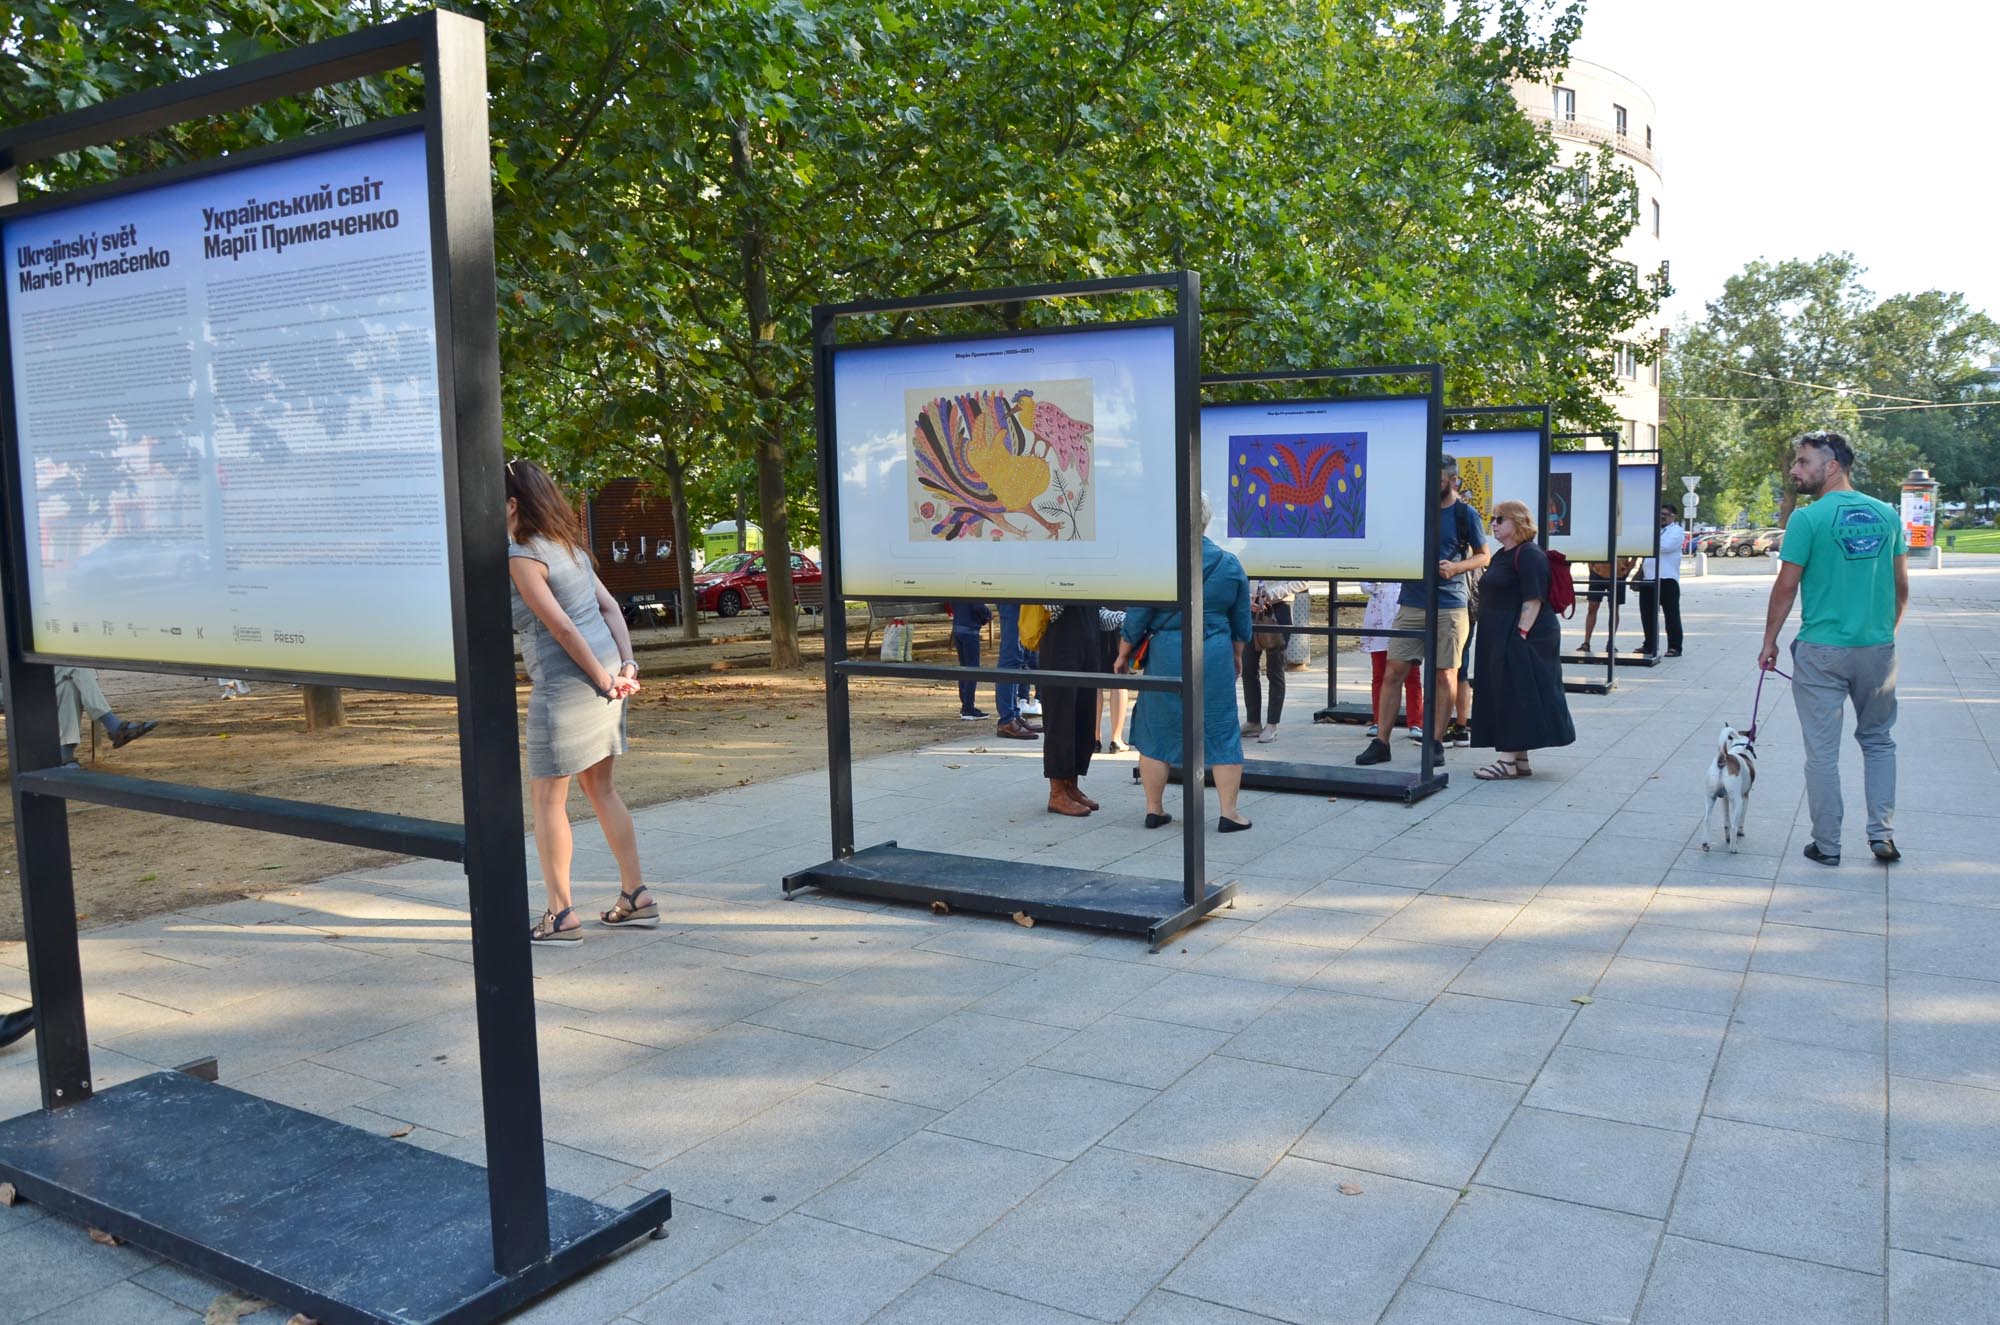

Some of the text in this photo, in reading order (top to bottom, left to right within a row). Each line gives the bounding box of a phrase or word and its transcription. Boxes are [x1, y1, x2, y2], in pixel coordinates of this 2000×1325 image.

[203, 176, 383, 234] Український світ
[17, 223, 137, 268] Ukrajinský svět
[204, 209, 399, 261] Марії Примаченко
[19, 246, 170, 293] Marie Prymačenko
[274, 633, 305, 644] PRESTO
